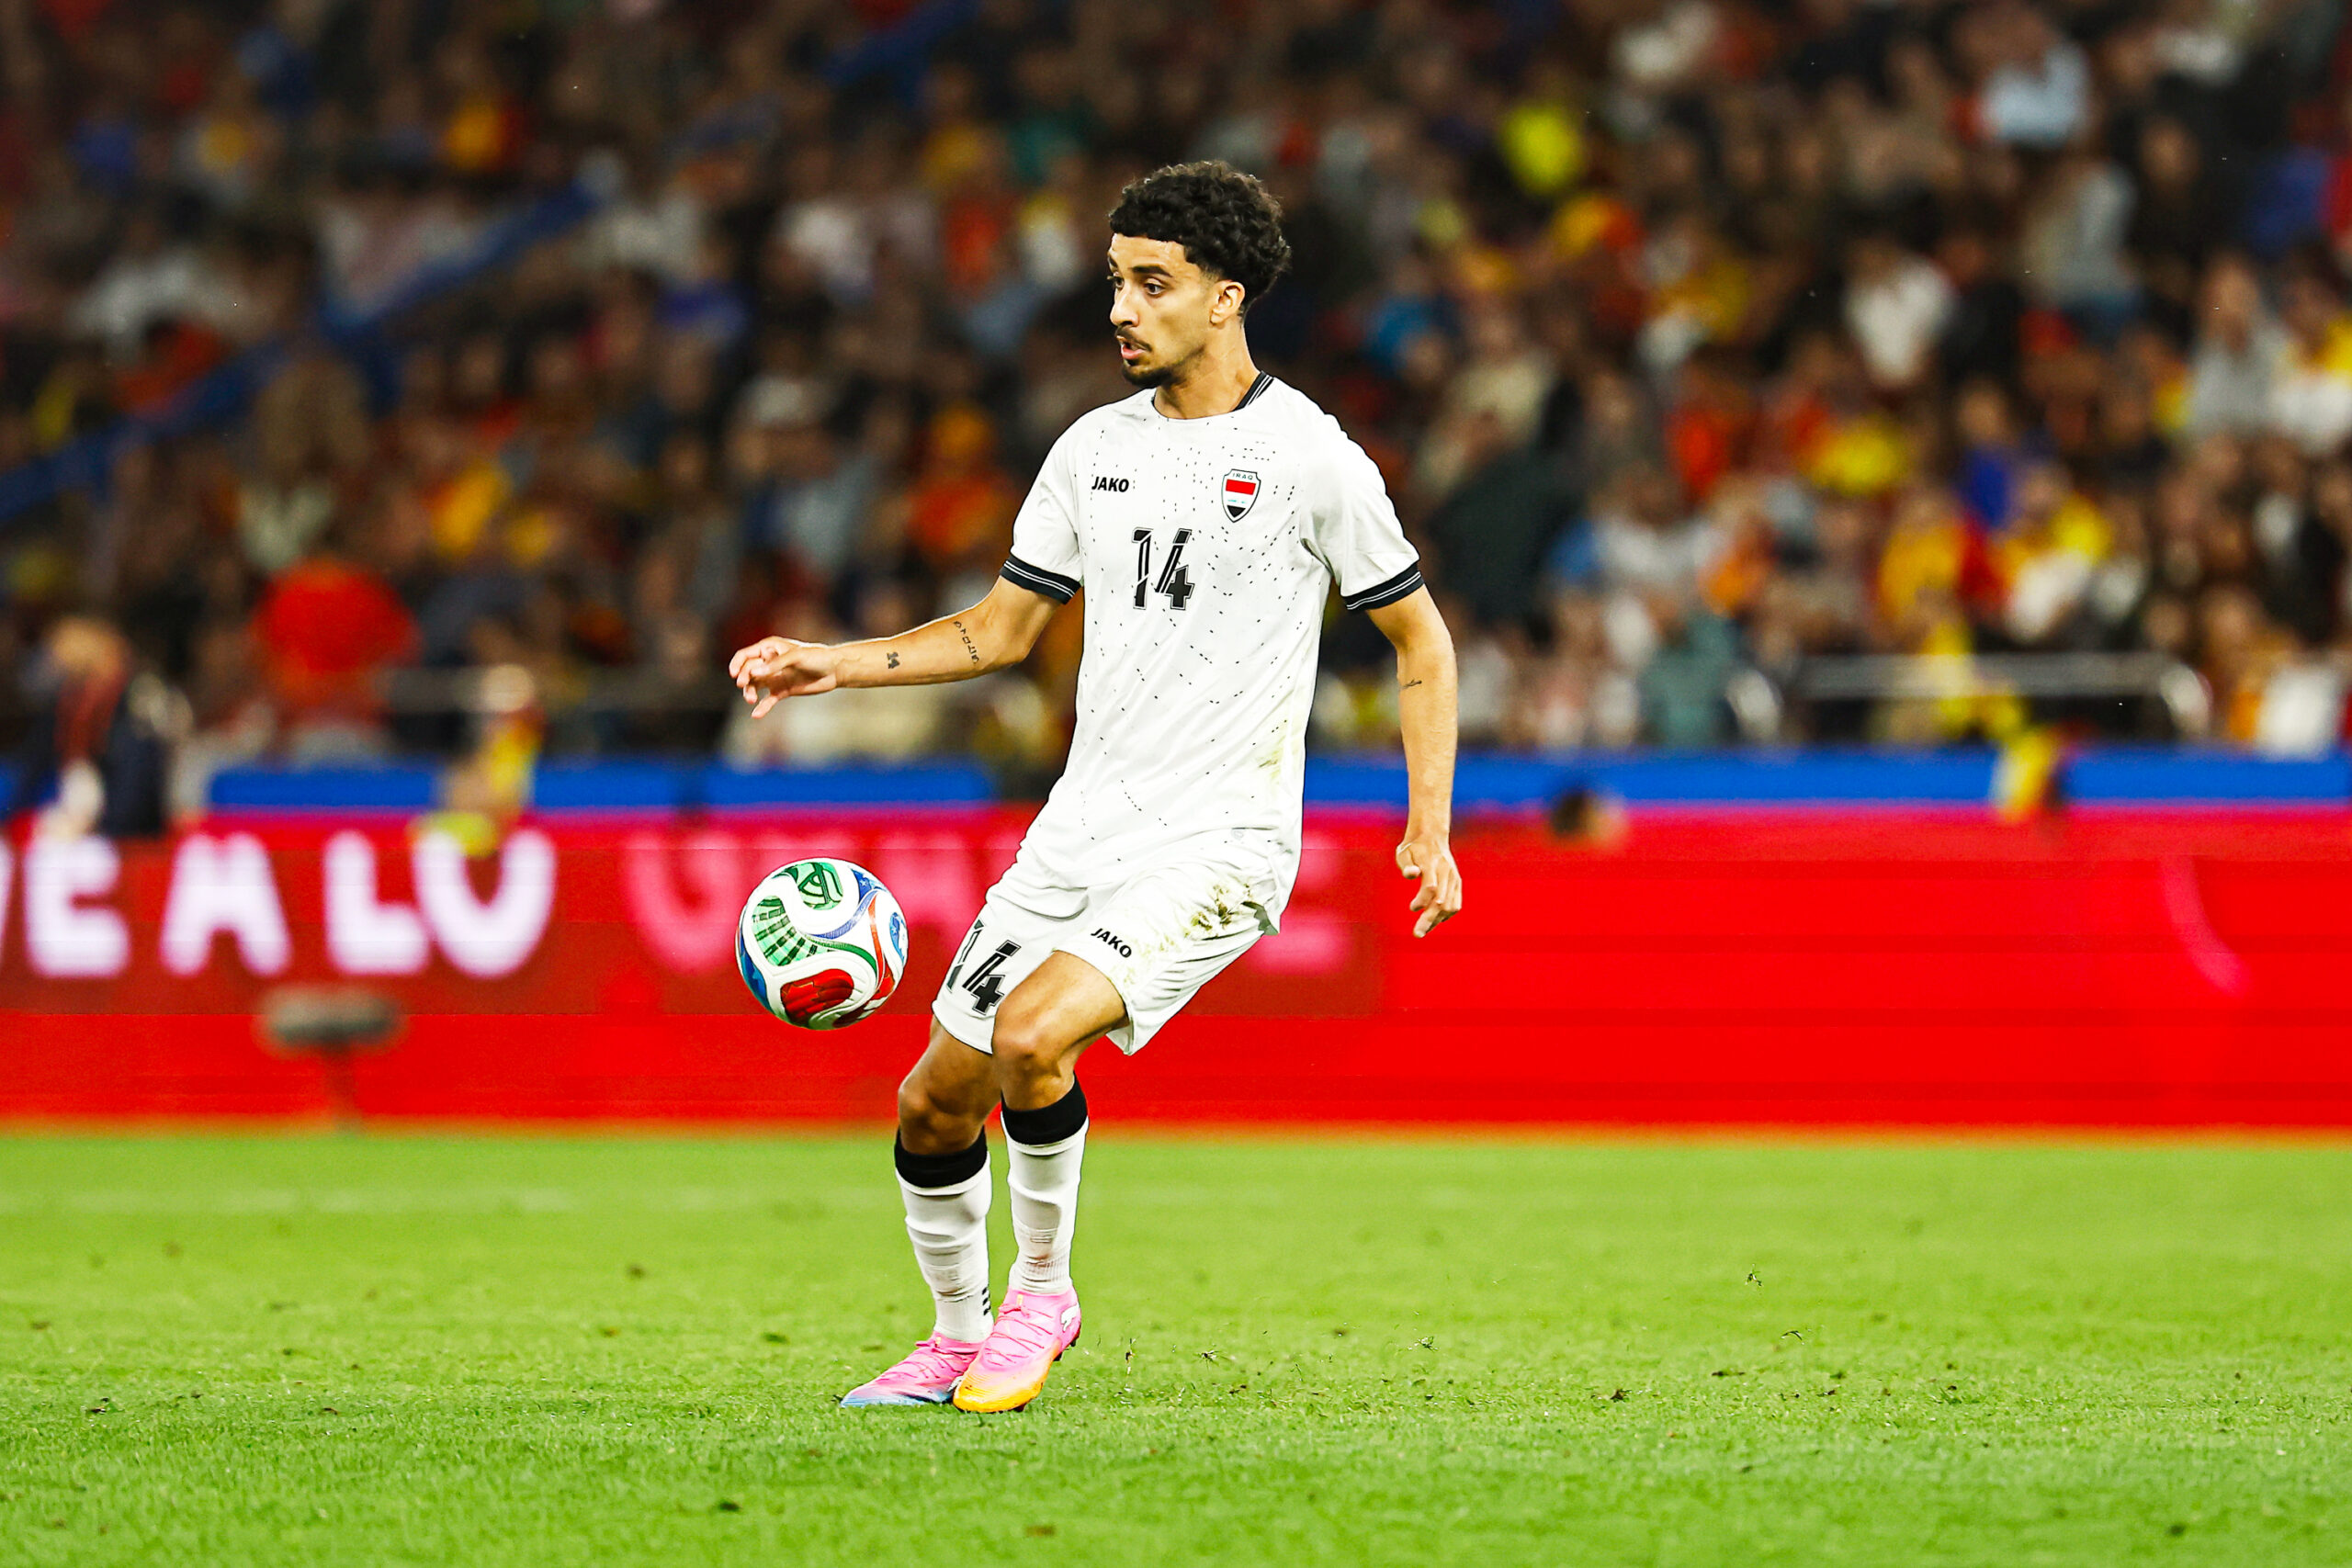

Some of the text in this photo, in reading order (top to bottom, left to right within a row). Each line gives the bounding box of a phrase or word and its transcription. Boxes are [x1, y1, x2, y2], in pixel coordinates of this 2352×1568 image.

[1091, 476, 1129, 493] JAKO
[1232, 472, 1254, 481] IRAQ
[1132, 526, 1195, 610] 14
[1091, 928, 1133, 958] JAKO
[945, 918, 1023, 1016] 14
